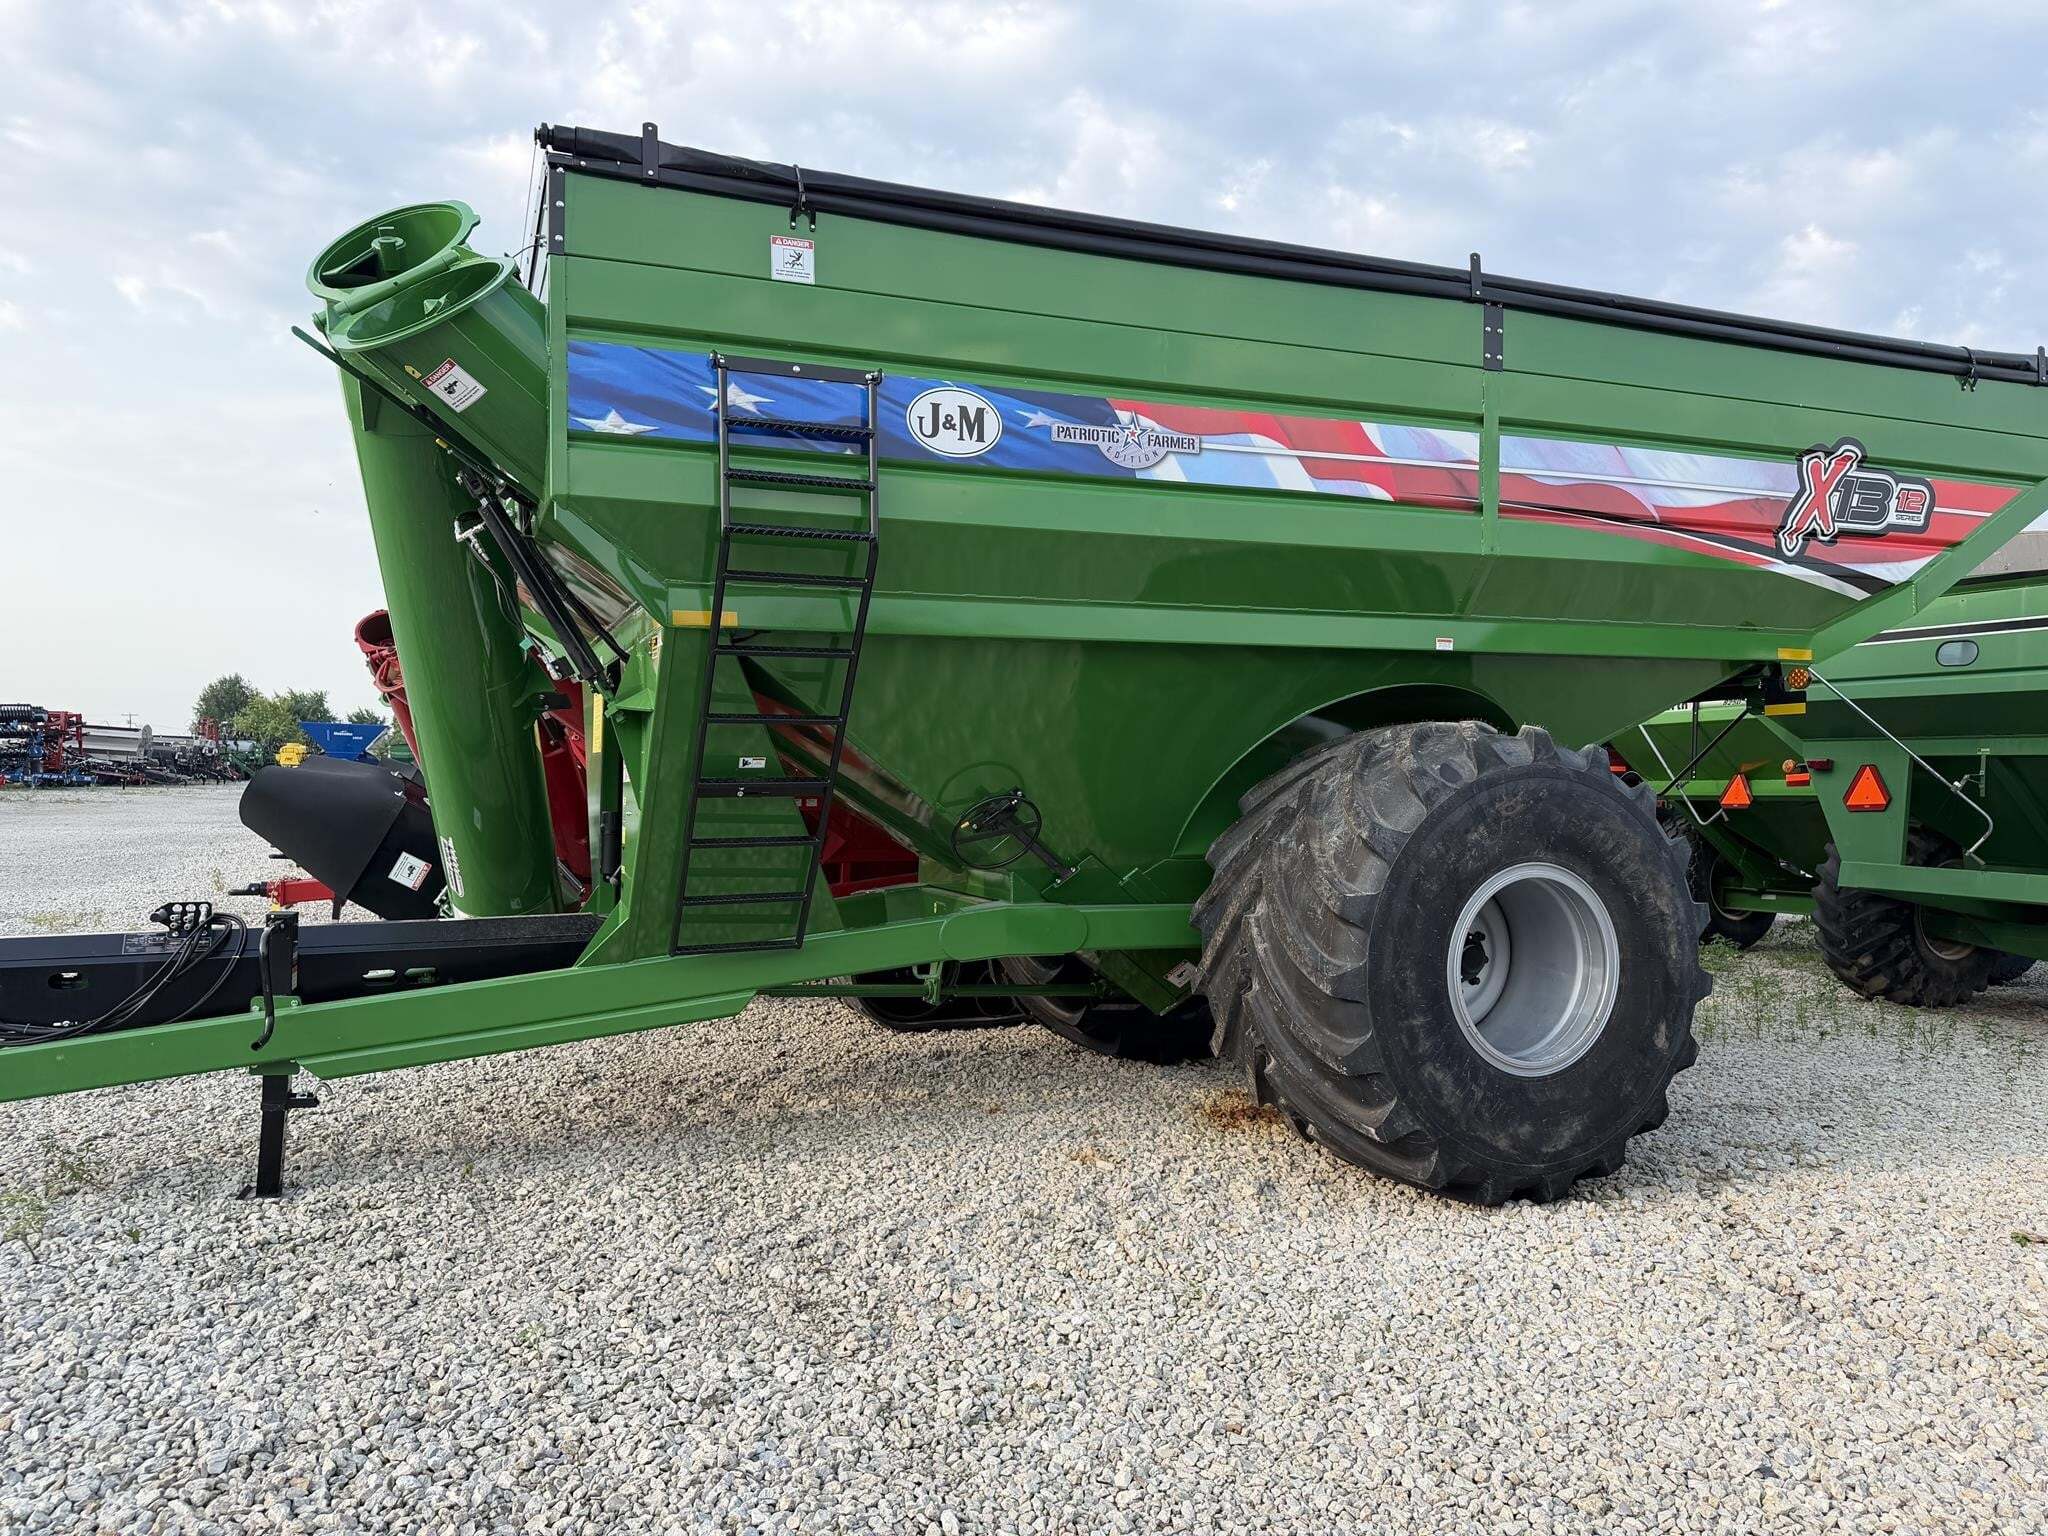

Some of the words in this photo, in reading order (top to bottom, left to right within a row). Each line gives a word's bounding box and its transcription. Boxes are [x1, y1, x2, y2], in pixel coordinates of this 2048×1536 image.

[782, 238, 810, 249] DANGER
[430, 363, 452, 382] DANGER
[917, 402, 987, 443] J&M
[1056, 425, 1120, 444] PATRIOTIC
[1147, 434, 1196, 451] FARMER
[1106, 445, 1159, 464] EDITION
[1895, 514, 1922, 522] SERIES
